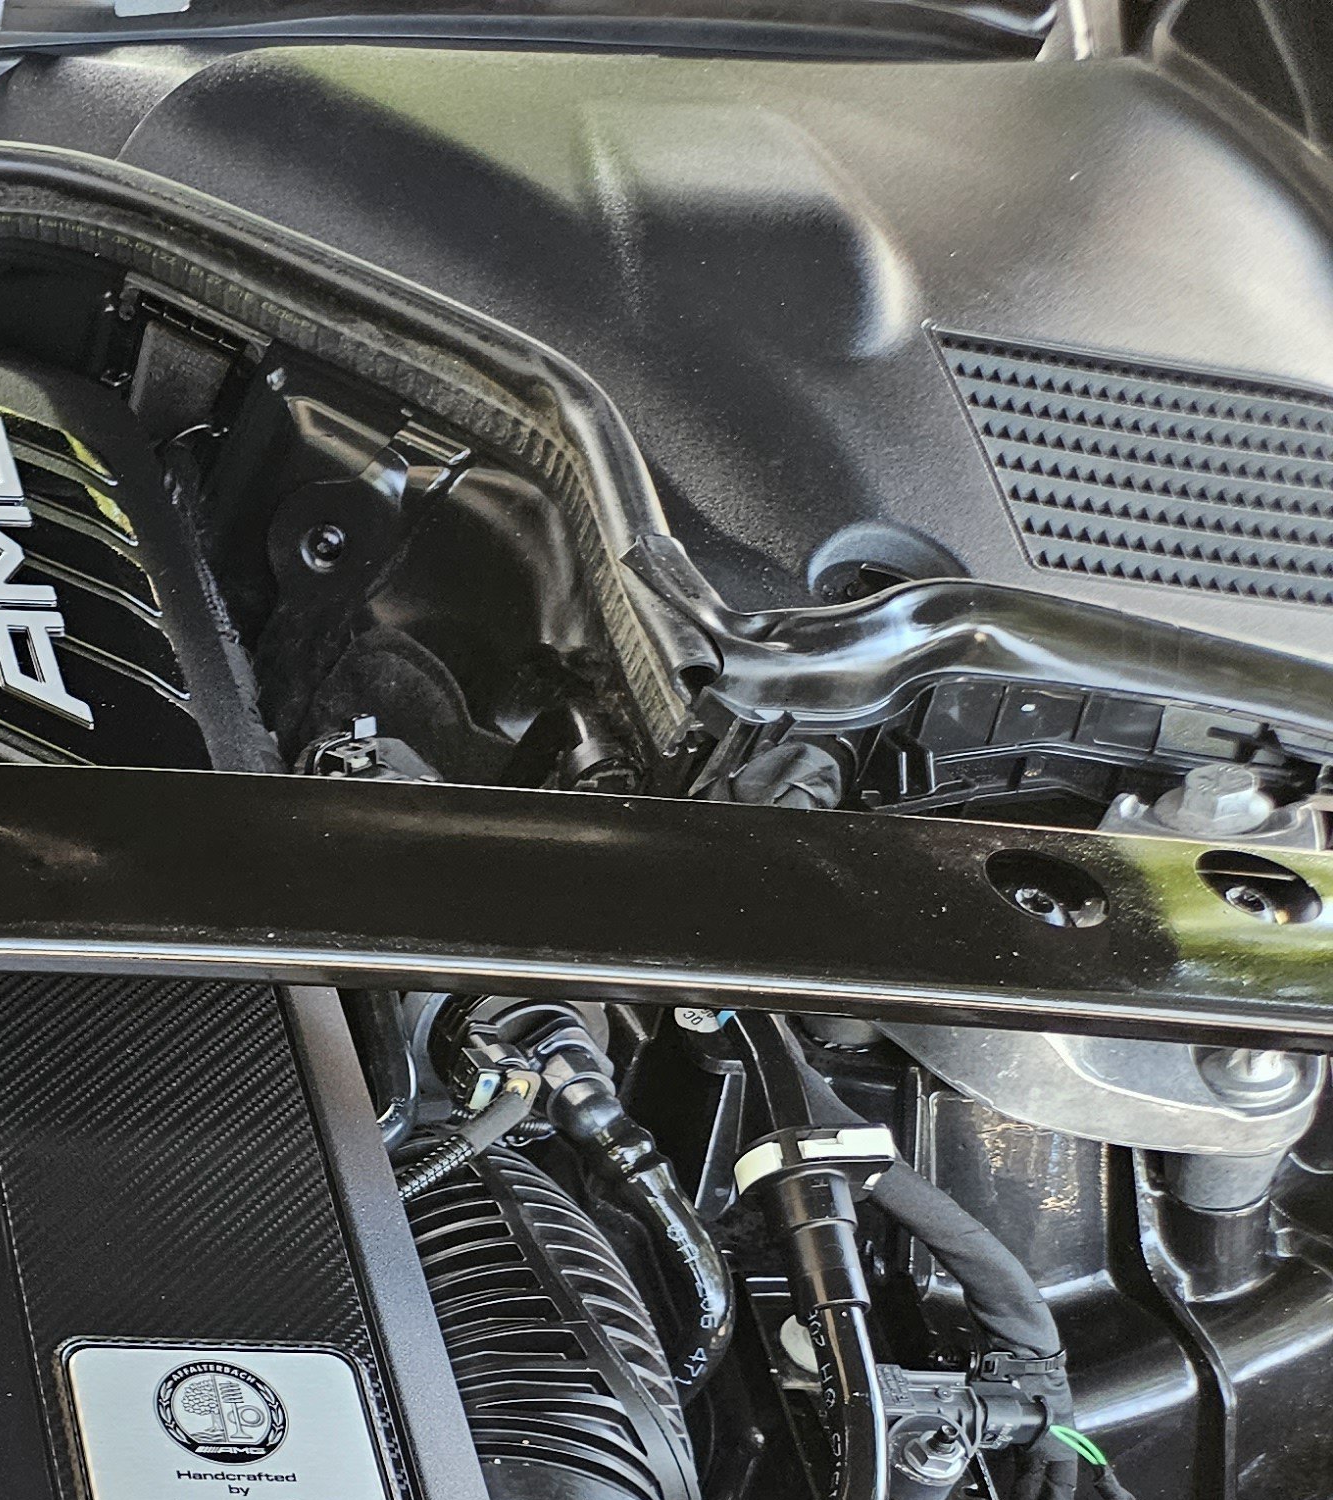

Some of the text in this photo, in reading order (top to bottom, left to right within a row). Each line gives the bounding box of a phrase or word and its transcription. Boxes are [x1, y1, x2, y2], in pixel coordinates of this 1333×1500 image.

[170, 1361, 257, 1385] AFFALTERBACH
[674, 1347, 709, 1386] 471
[175, 1469, 297, 1483] Handcrafted
[228, 1484, 251, 1497] by
